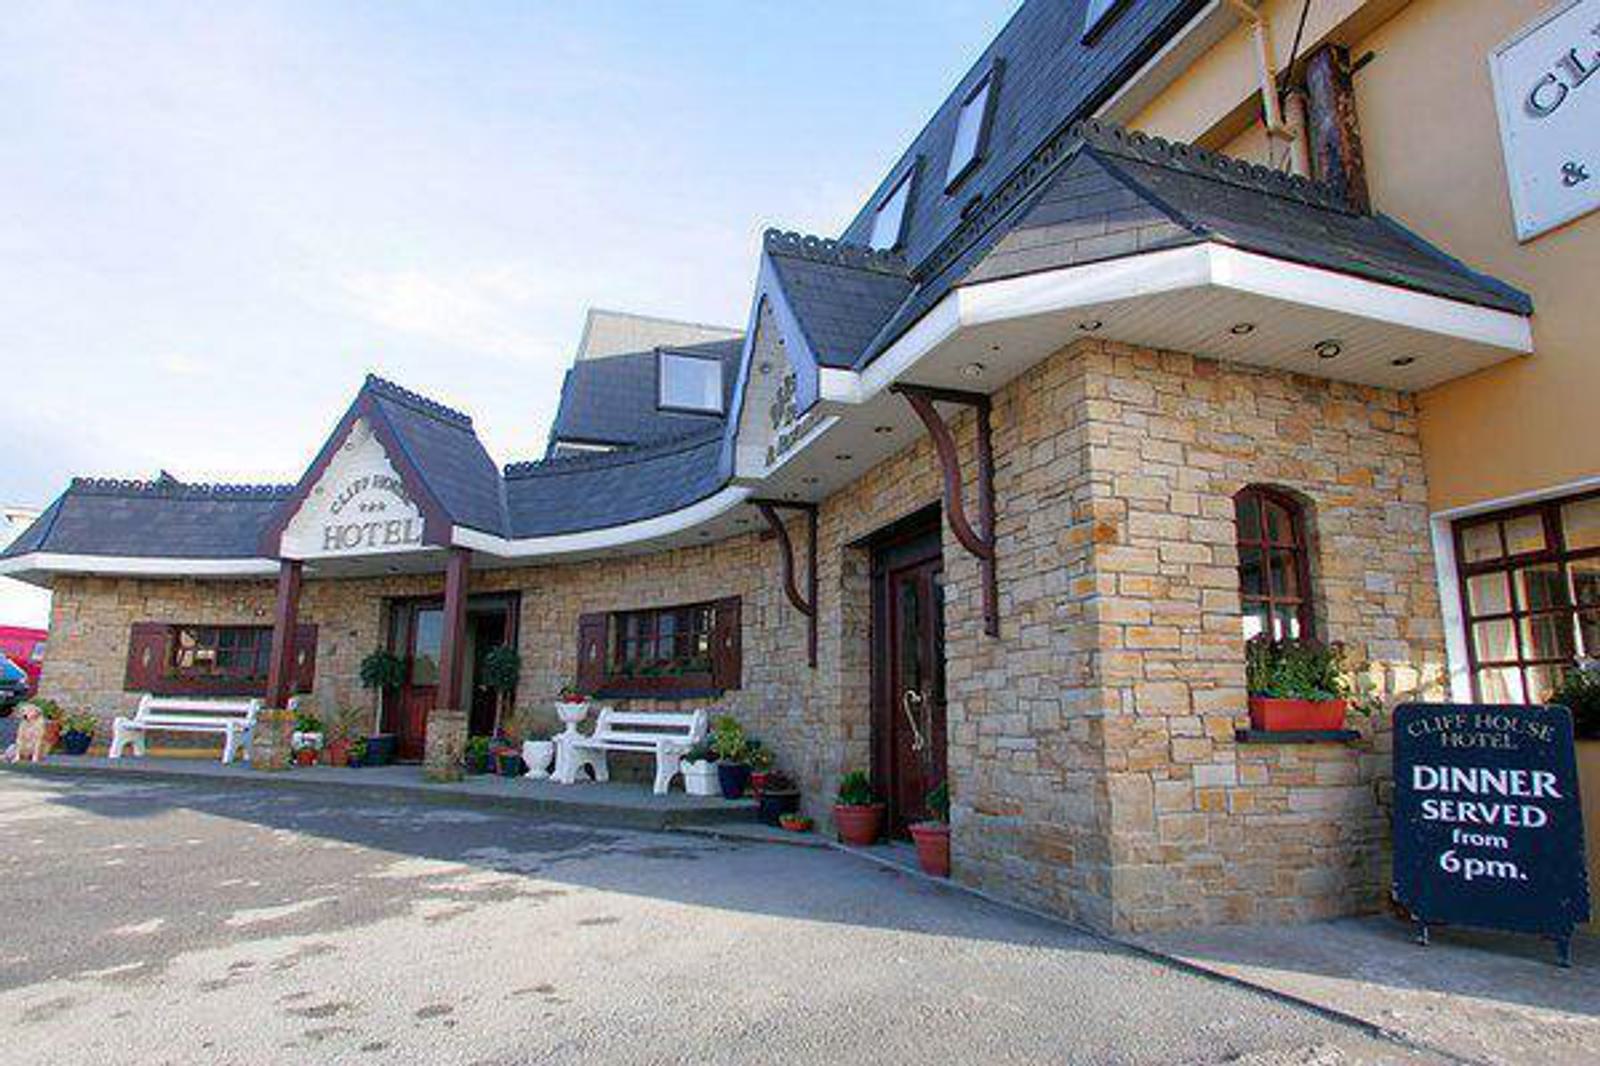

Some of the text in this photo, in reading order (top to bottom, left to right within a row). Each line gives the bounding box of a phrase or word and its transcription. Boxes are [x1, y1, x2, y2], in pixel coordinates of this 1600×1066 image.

[1525, 22, 1600, 118] CL
[1561, 161, 1590, 188] &
[322, 518, 421, 550] HOTEL
[1408, 713, 1554, 742] CLIFF HOUSE
[1441, 732, 1518, 750] HOTEL
[1412, 765, 1562, 799] DINNER
[1421, 799, 1548, 828] SERVED
[1452, 828, 1509, 849] from
[1439, 850, 1528, 881] 6pm.
